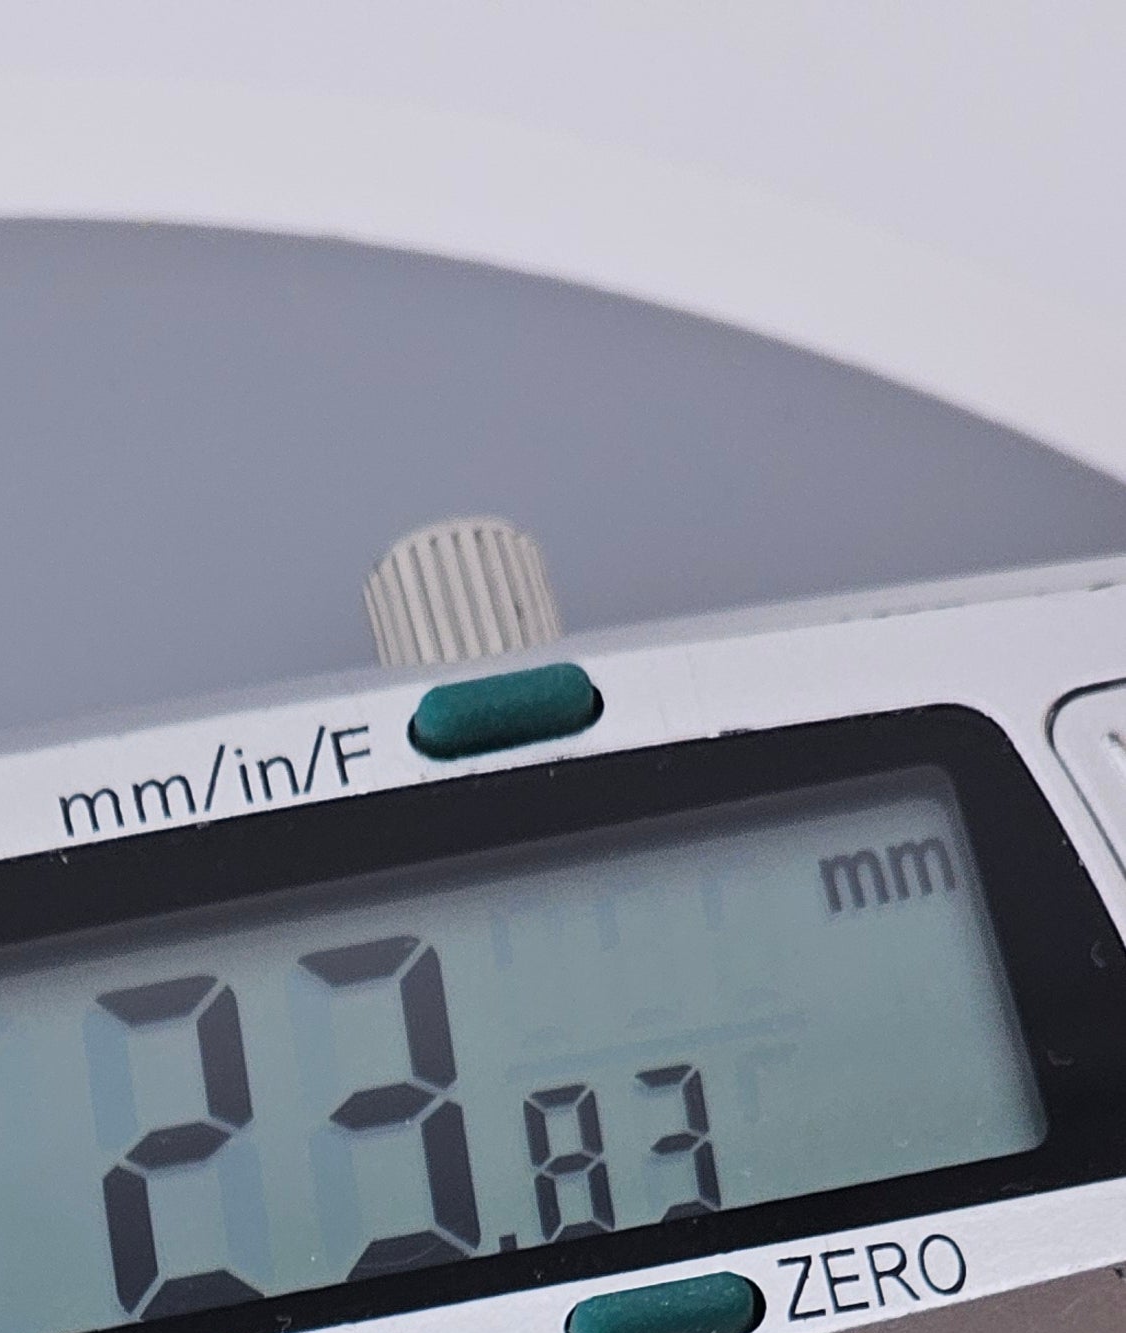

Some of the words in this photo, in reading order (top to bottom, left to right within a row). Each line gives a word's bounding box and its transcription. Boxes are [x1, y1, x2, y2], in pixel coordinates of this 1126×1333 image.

[58, 725, 371, 837] mm/in/F
[818, 838, 957, 915] mm
[776, 1233, 967, 1322] ZERO
